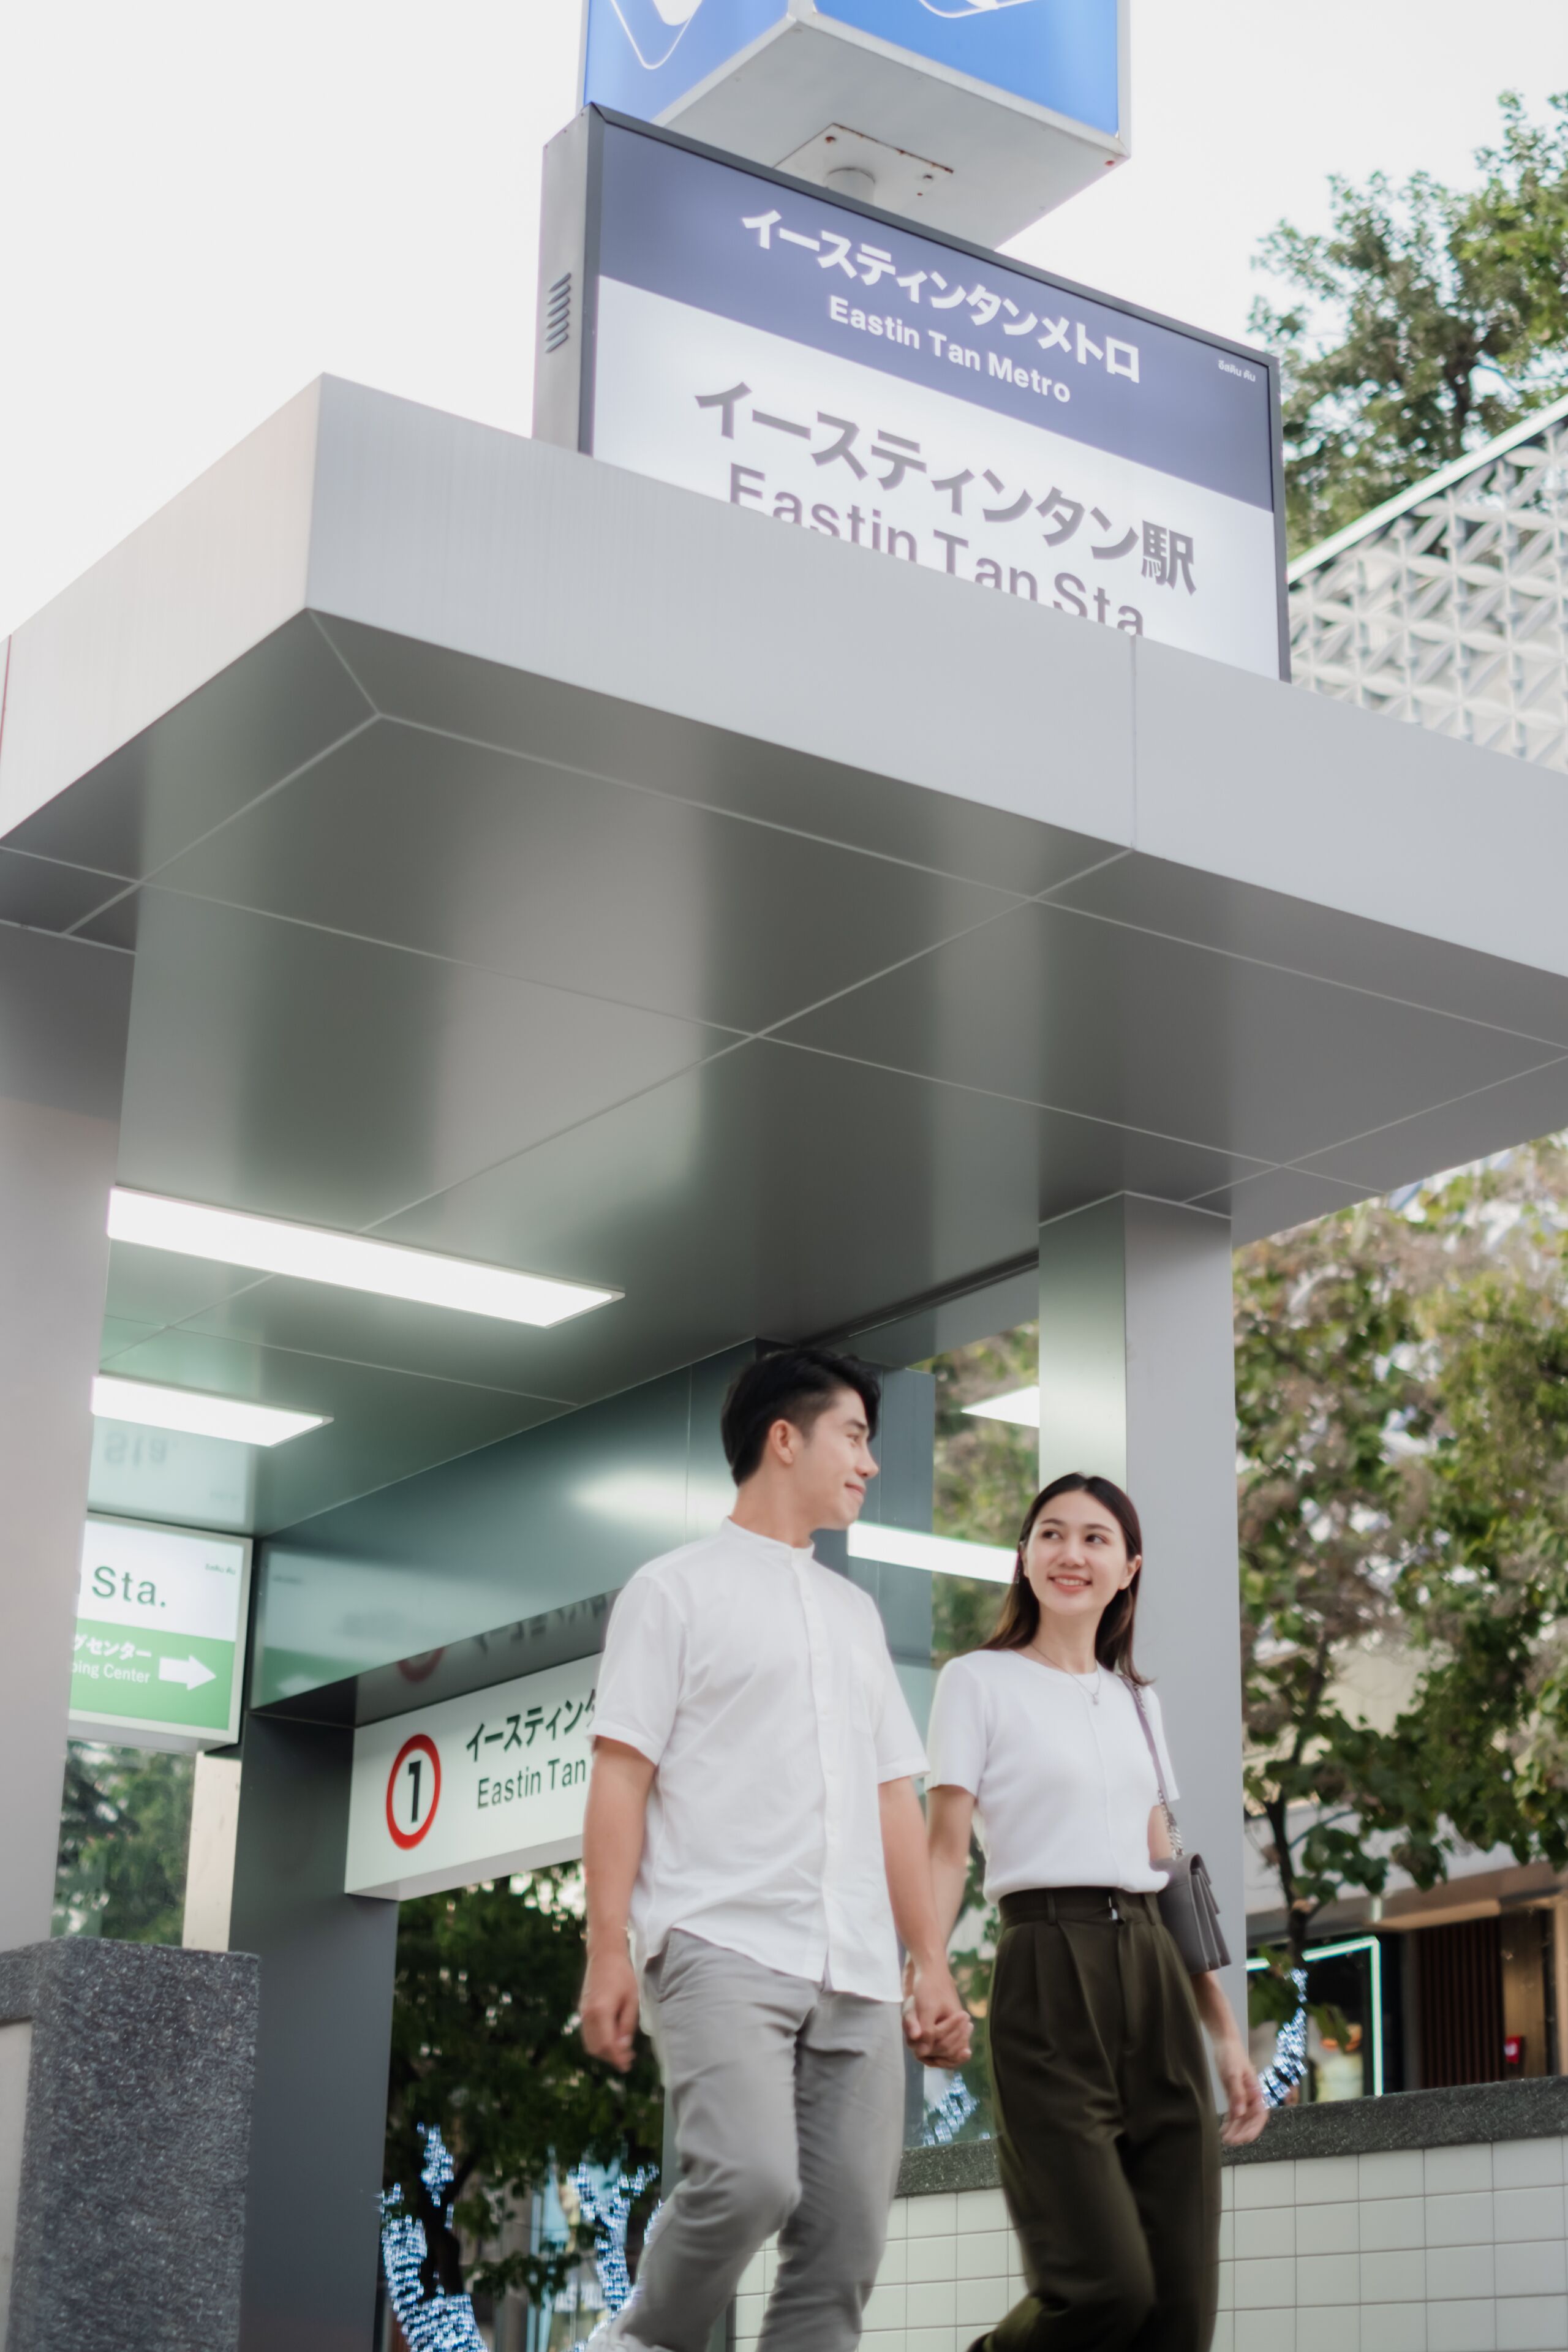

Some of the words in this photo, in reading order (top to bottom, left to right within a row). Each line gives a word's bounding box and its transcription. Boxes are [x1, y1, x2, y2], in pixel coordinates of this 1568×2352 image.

[742, 209, 1140, 383] イースティンタンメトロ
[830, 295, 919, 349] Eastin
[928, 330, 980, 371] Tan
[989, 352, 1071, 403] Metro
[695, 382, 1197, 596] イースティンタン駅
[730, 462, 917, 564] Eastin
[933, 529, 1038, 603] Tan
[92, 1566, 166, 1608] Sta.
[104, 1663, 151, 1683] Center
[407, 1760, 423, 1823] 1
[477, 1766, 541, 1809] Eastin
[548, 1758, 586, 1790] Tan
